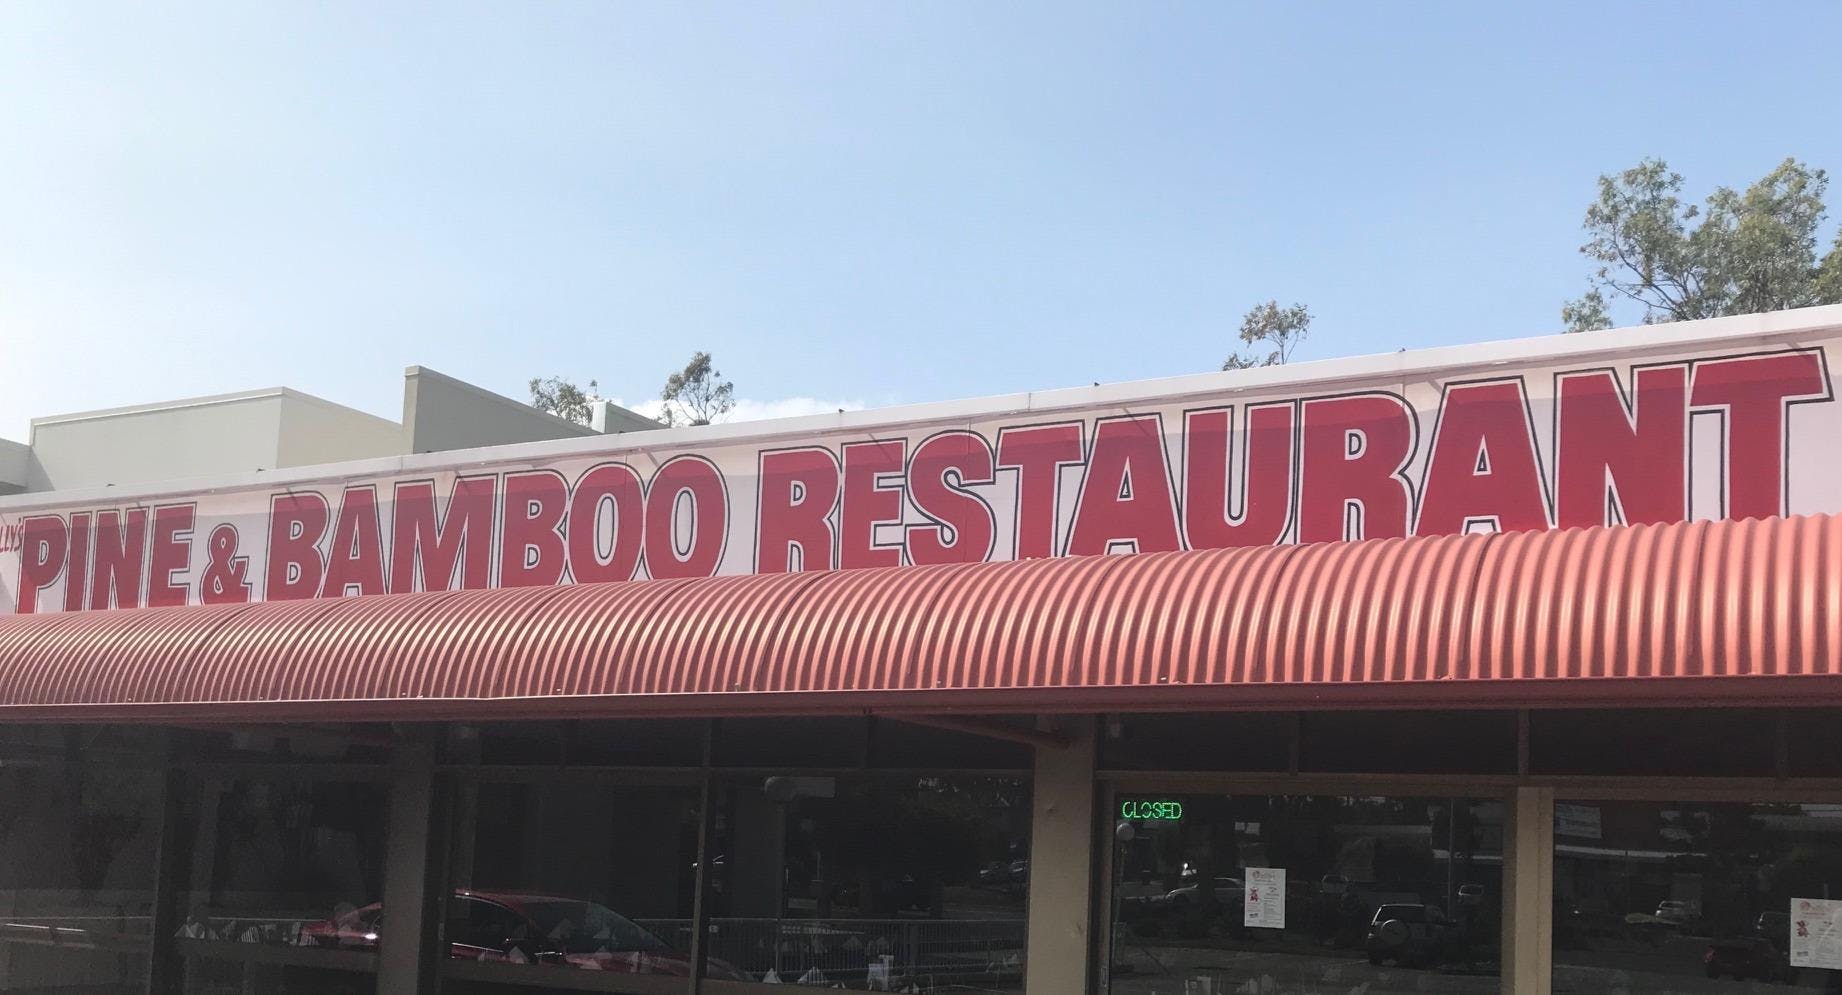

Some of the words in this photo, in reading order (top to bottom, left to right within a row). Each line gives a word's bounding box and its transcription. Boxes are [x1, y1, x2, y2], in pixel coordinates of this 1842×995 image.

[15, 501, 197, 614] PINE
[200, 523, 253, 605] &
[264, 453, 730, 602] BAMBOO
[755, 346, 1834, 574] RESTAURANT
[1122, 801, 1182, 819] CLOSED
